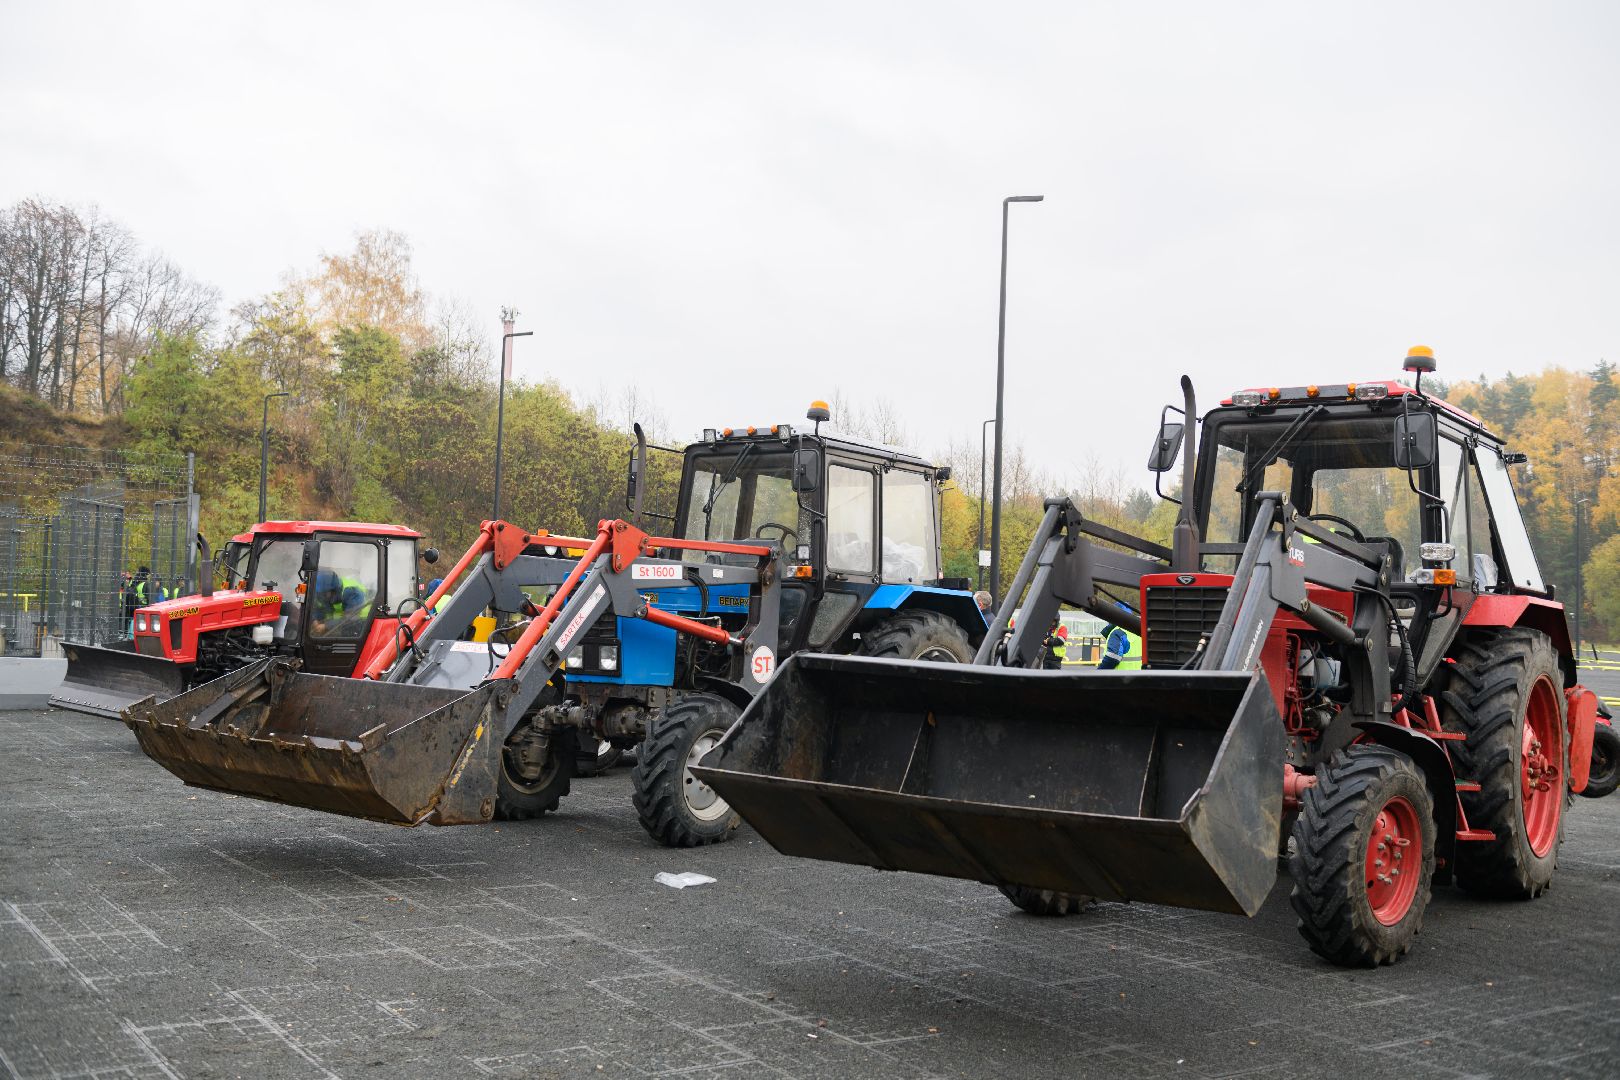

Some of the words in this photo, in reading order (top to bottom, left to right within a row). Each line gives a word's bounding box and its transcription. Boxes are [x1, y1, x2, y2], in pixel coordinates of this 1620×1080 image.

[639, 566, 649, 577] St
[652, 566, 675, 577] 1600
[719, 595, 750, 607] БЕЛАРУ
[754, 656, 772, 674] ST
